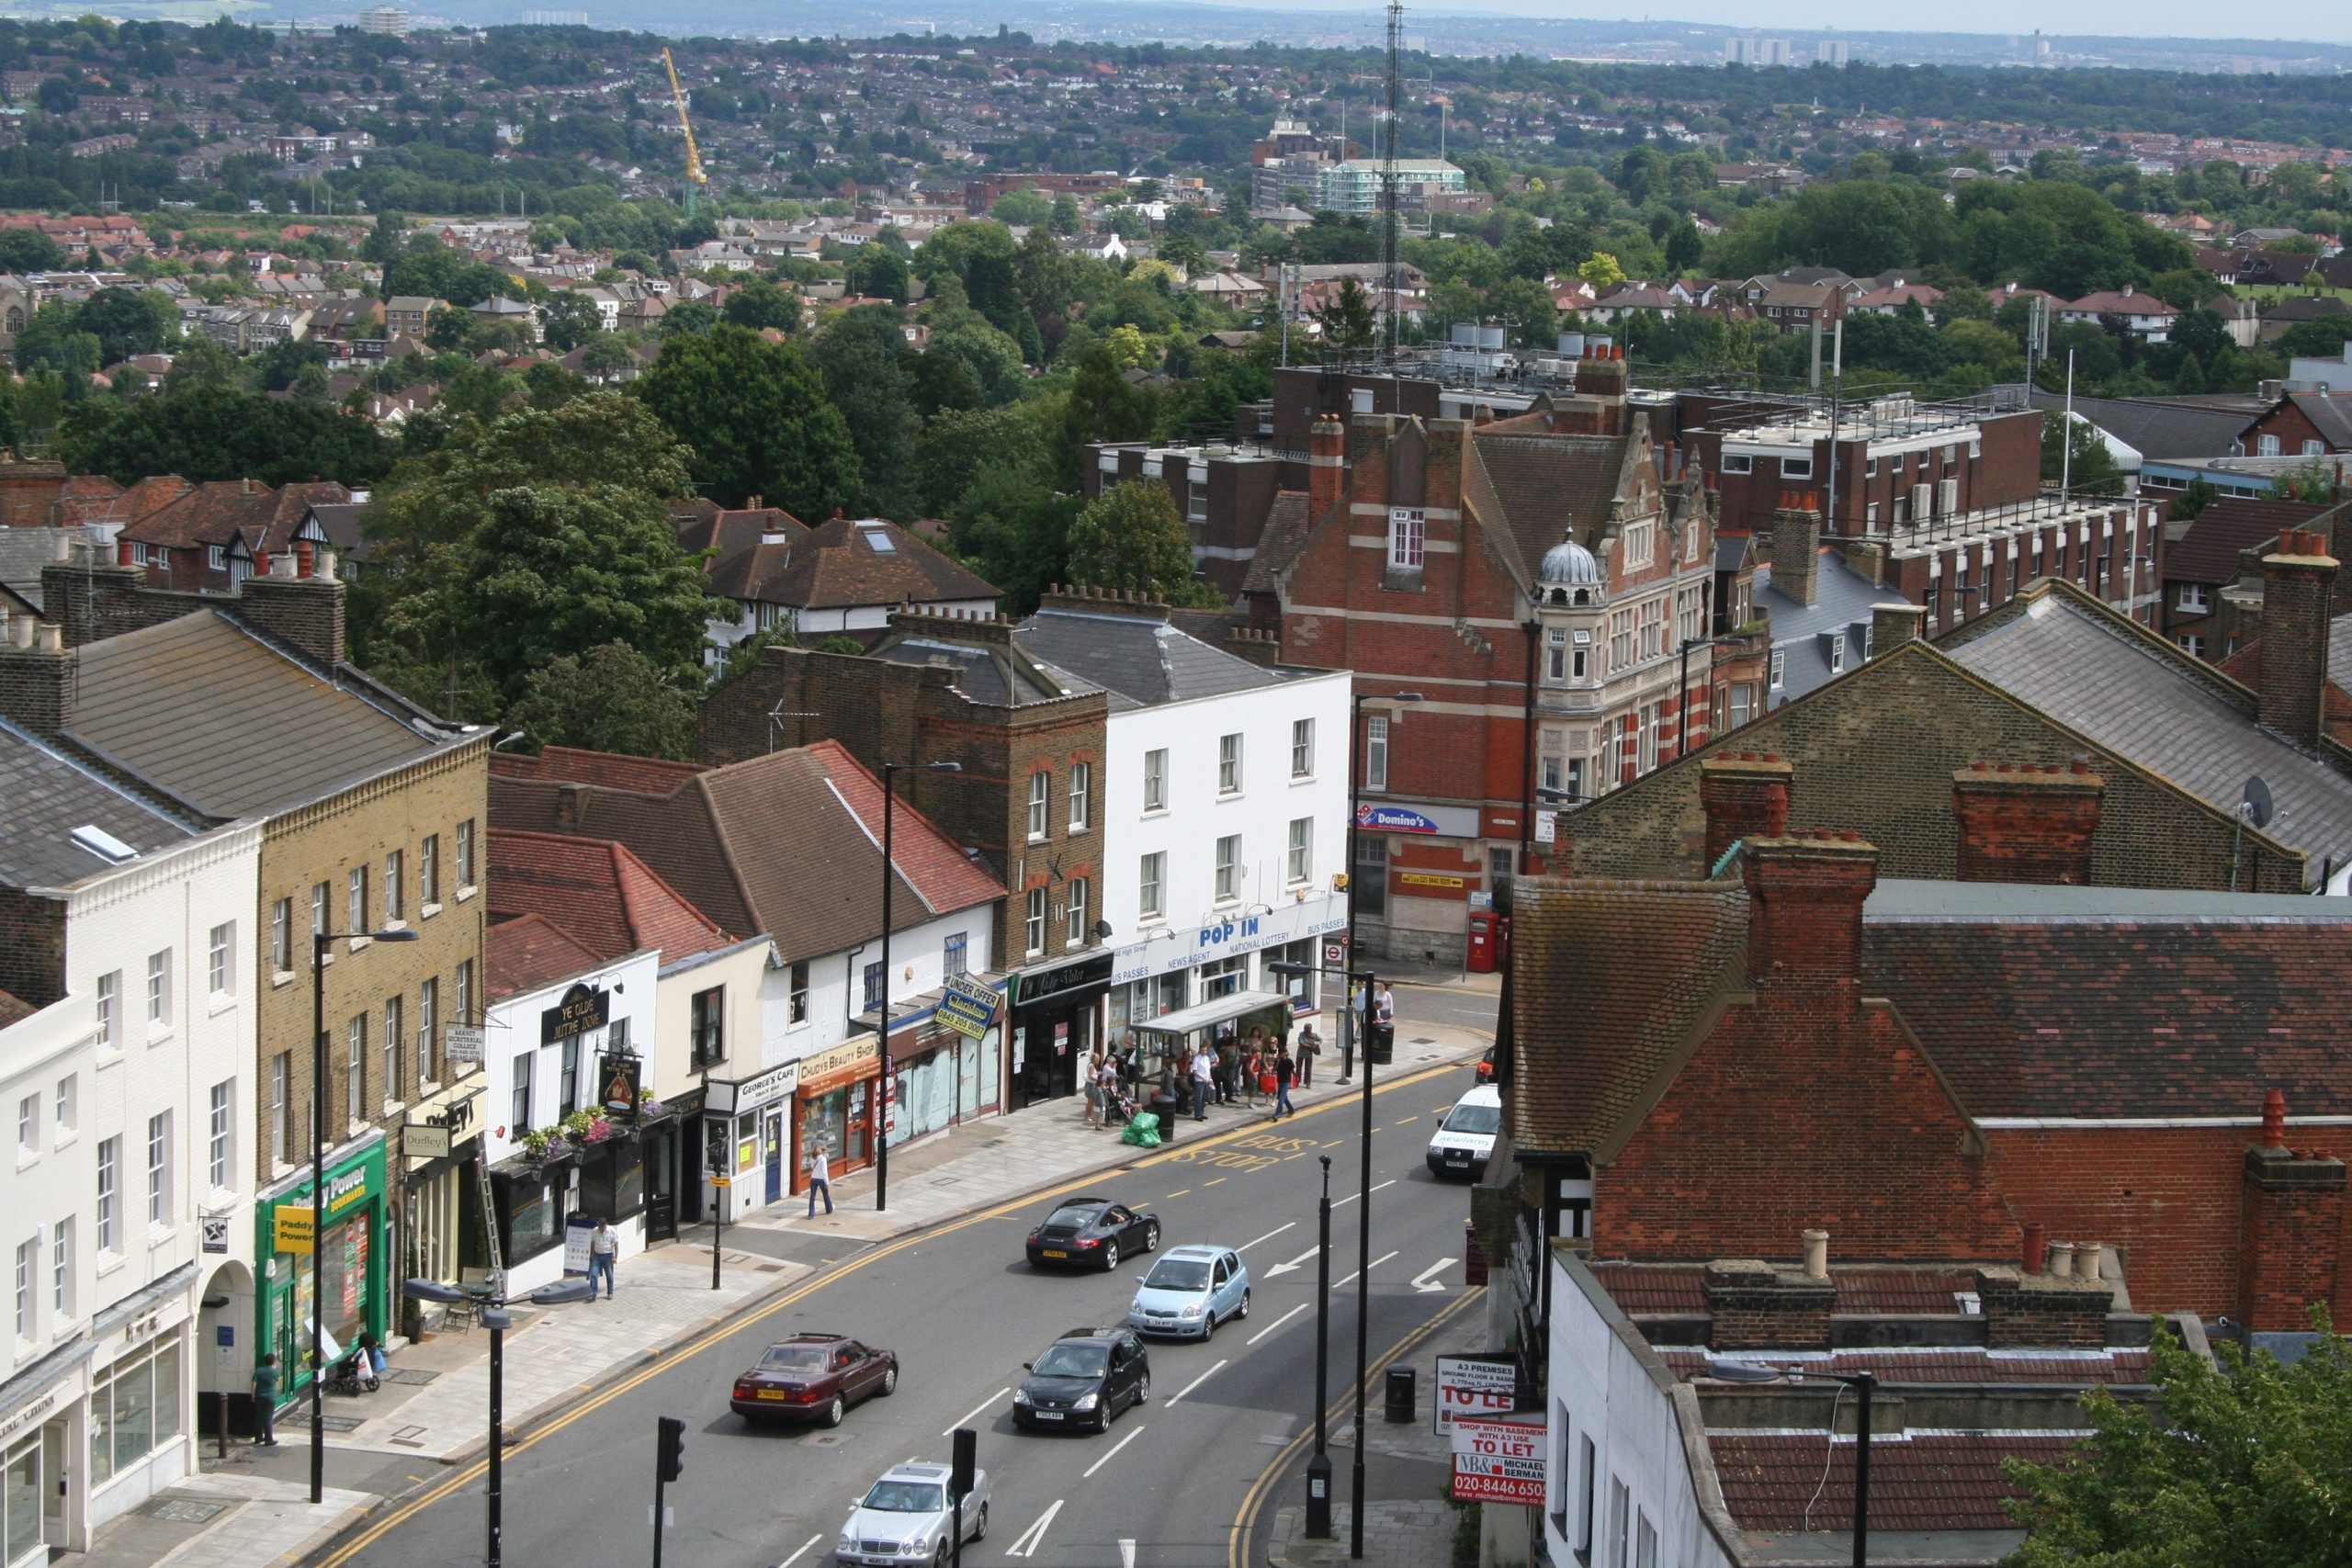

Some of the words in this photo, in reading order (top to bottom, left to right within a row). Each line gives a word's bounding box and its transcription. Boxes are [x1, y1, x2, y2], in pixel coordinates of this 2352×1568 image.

[1378, 813, 1424, 827] Domino's
[1200, 923, 1234, 947] POP
[1241, 917, 1259, 937] IN
[1308, 923, 1320, 935] BUS
[1321, 919, 1345, 931] PASSES
[1229, 939, 1261, 954] NATIONAL
[1261, 931, 1290, 947] LOTTERY
[1341, 936, 1349, 945] G
[1168, 957, 1187, 970] NEWS
[1188, 951, 1211, 965] AGENT
[1124, 965, 1149, 980] PASSES
[950, 976, 974, 996] UNDER
[974, 987, 997, 1007] OFFER
[561, 1005, 572, 1021] YE
[574, 998, 594, 1017] OLDE
[938, 1010, 956, 1022] 0845
[955, 1016, 967, 1028] 205
[553, 1020, 579, 1040] MITRE
[829, 1051, 855, 1068] BEAUTY
[856, 1044, 875, 1058] SHOP
[741, 1076, 776, 1096] GEORGE'S
[406, 1134, 447, 1148] Dudley's
[1231, 1134, 1317, 1152] BUS
[332, 1165, 366, 1200] Power
[280, 1220, 313, 1231] Paddy
[280, 1232, 314, 1241] Power
[1472, 1365, 1513, 1375] PREMISES
[1441, 1385, 1475, 1405] TO
[1459, 1423, 1481, 1431] SHOP
[1483, 1425, 1503, 1433] WITH
[1506, 1427, 1547, 1437] BASEMENT
[1477, 1432, 1498, 1440] WITH
[1472, 1438, 1497, 1454] TO
[1502, 1441, 1535, 1458] LET
[1504, 1460, 1544, 1471] MICHAEL
[1504, 1468, 1544, 1480] BERMAN
[1454, 1475, 1516, 1495] 020-8446
